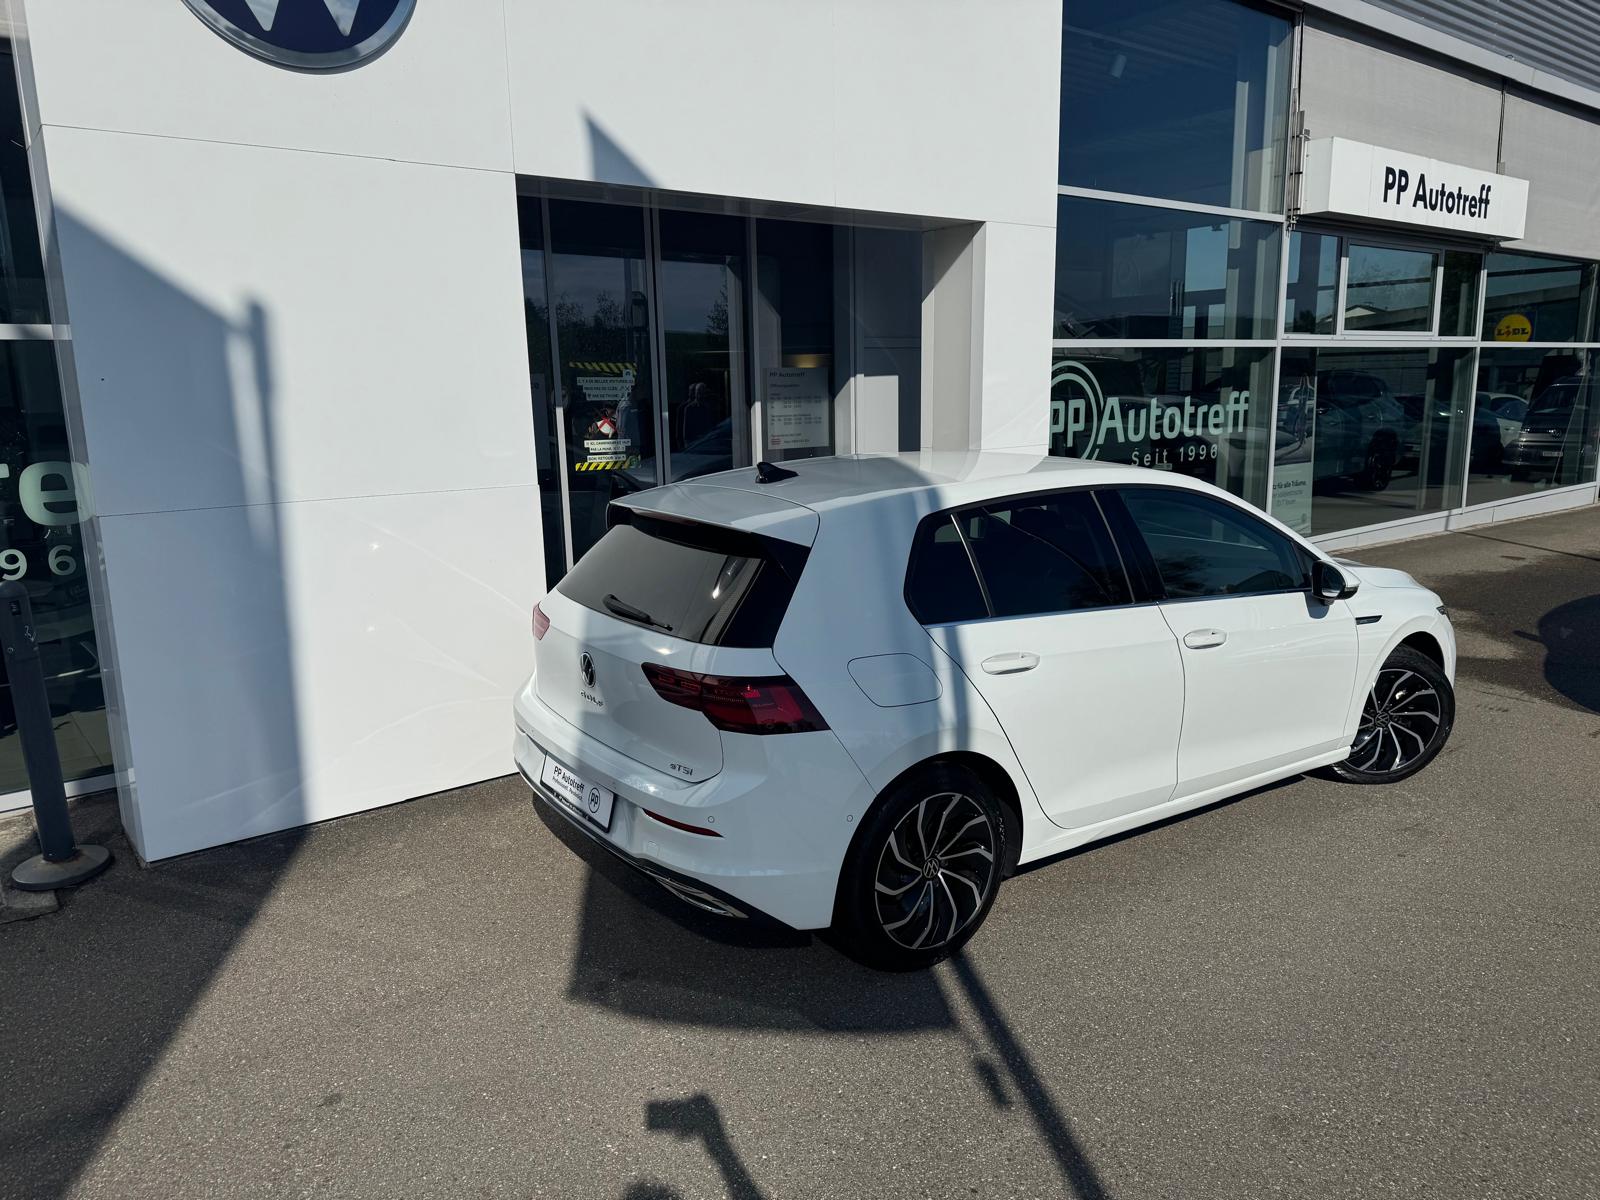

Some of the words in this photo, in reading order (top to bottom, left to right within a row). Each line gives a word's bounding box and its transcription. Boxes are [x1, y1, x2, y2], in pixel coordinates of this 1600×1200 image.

[1383, 166, 1409, 205] PP
[1412, 173, 1492, 219] Autotreff
[1096, 390, 1250, 445] Autotreff
[1131, 448, 1168, 466] Seit
[1179, 444, 1218, 463] 1996
[562, 772, 585, 793] Autotreff
